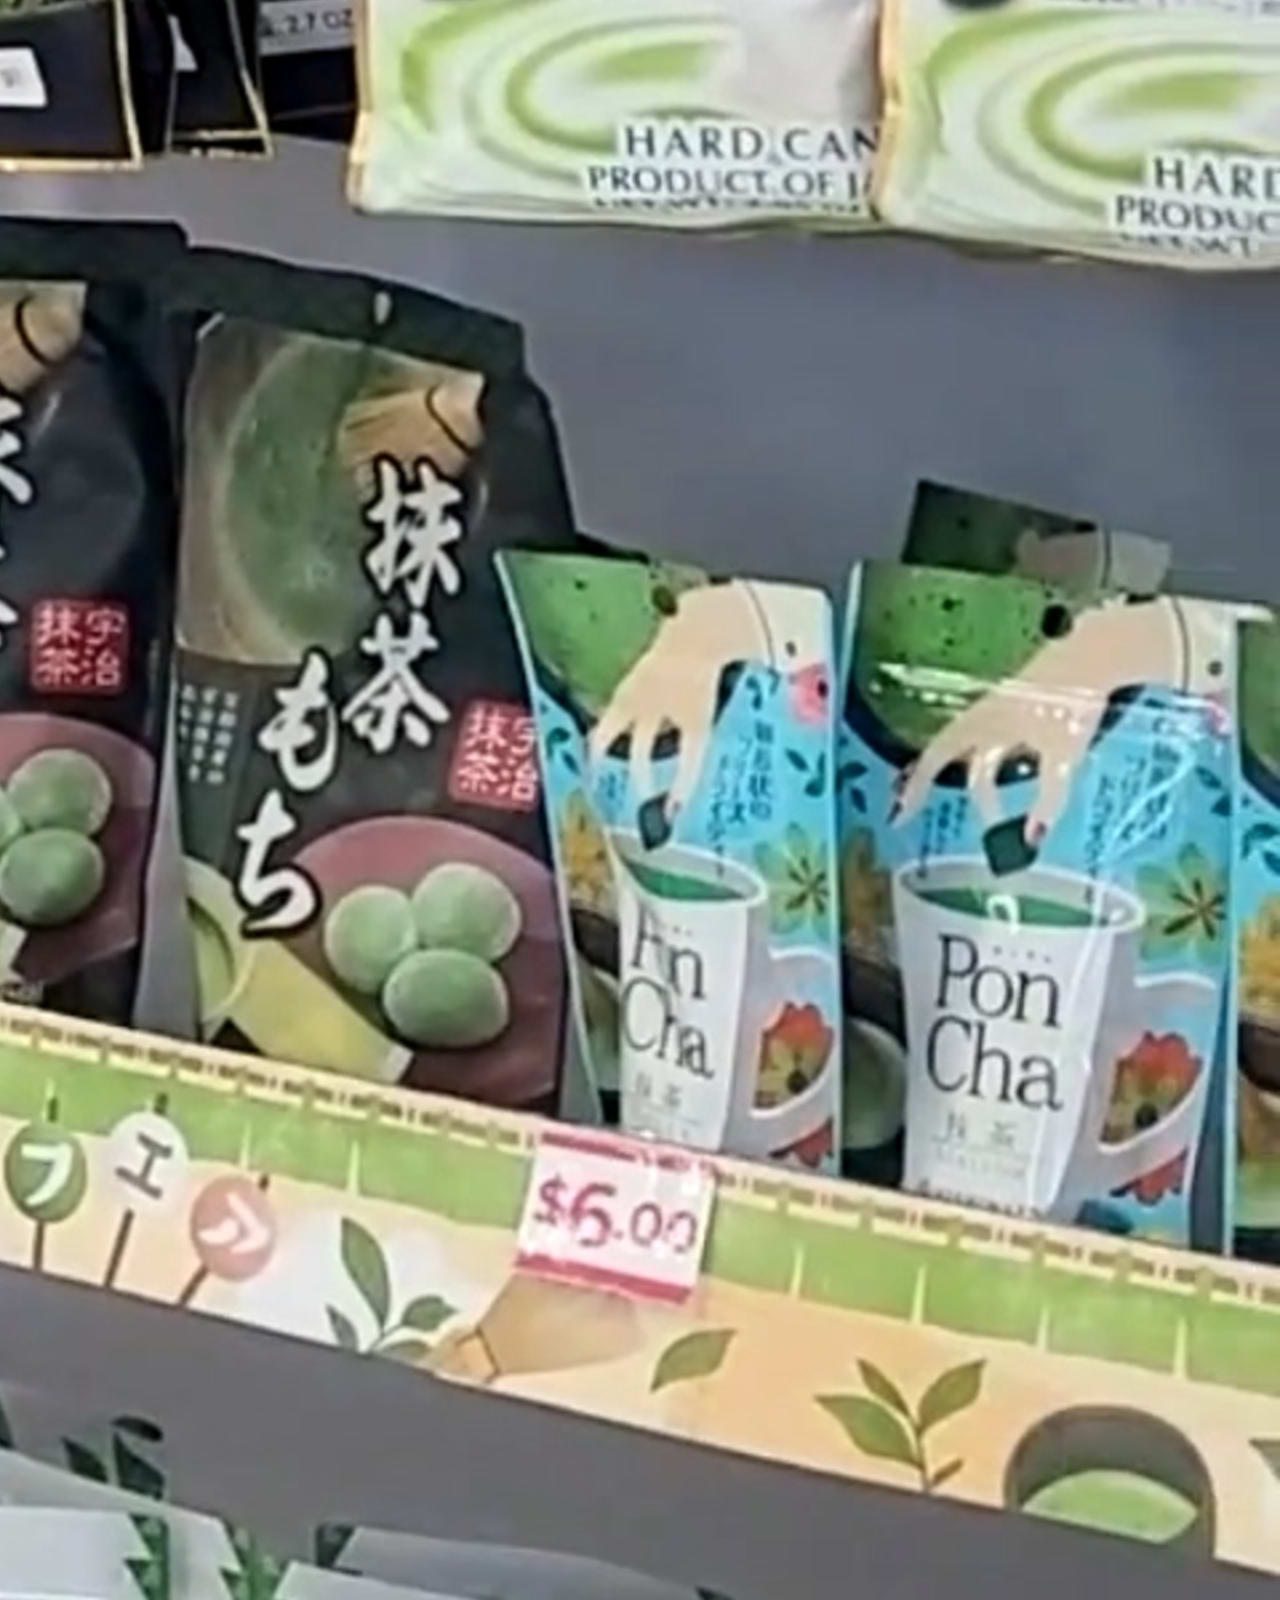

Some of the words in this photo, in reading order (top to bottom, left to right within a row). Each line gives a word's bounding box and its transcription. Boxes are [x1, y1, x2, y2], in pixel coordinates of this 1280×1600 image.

[589, 167, 761, 198] PRODUCT
[775, 168, 834, 198] OF
[625, 123, 765, 162] HARD
[340, 459, 465, 751] 抹茶
[235, 652, 341, 933] もち
[939, 933, 1062, 1029] Pon
[926, 1018, 1063, 1111] Cha
[533, 1175, 699, 1258] $6.00
